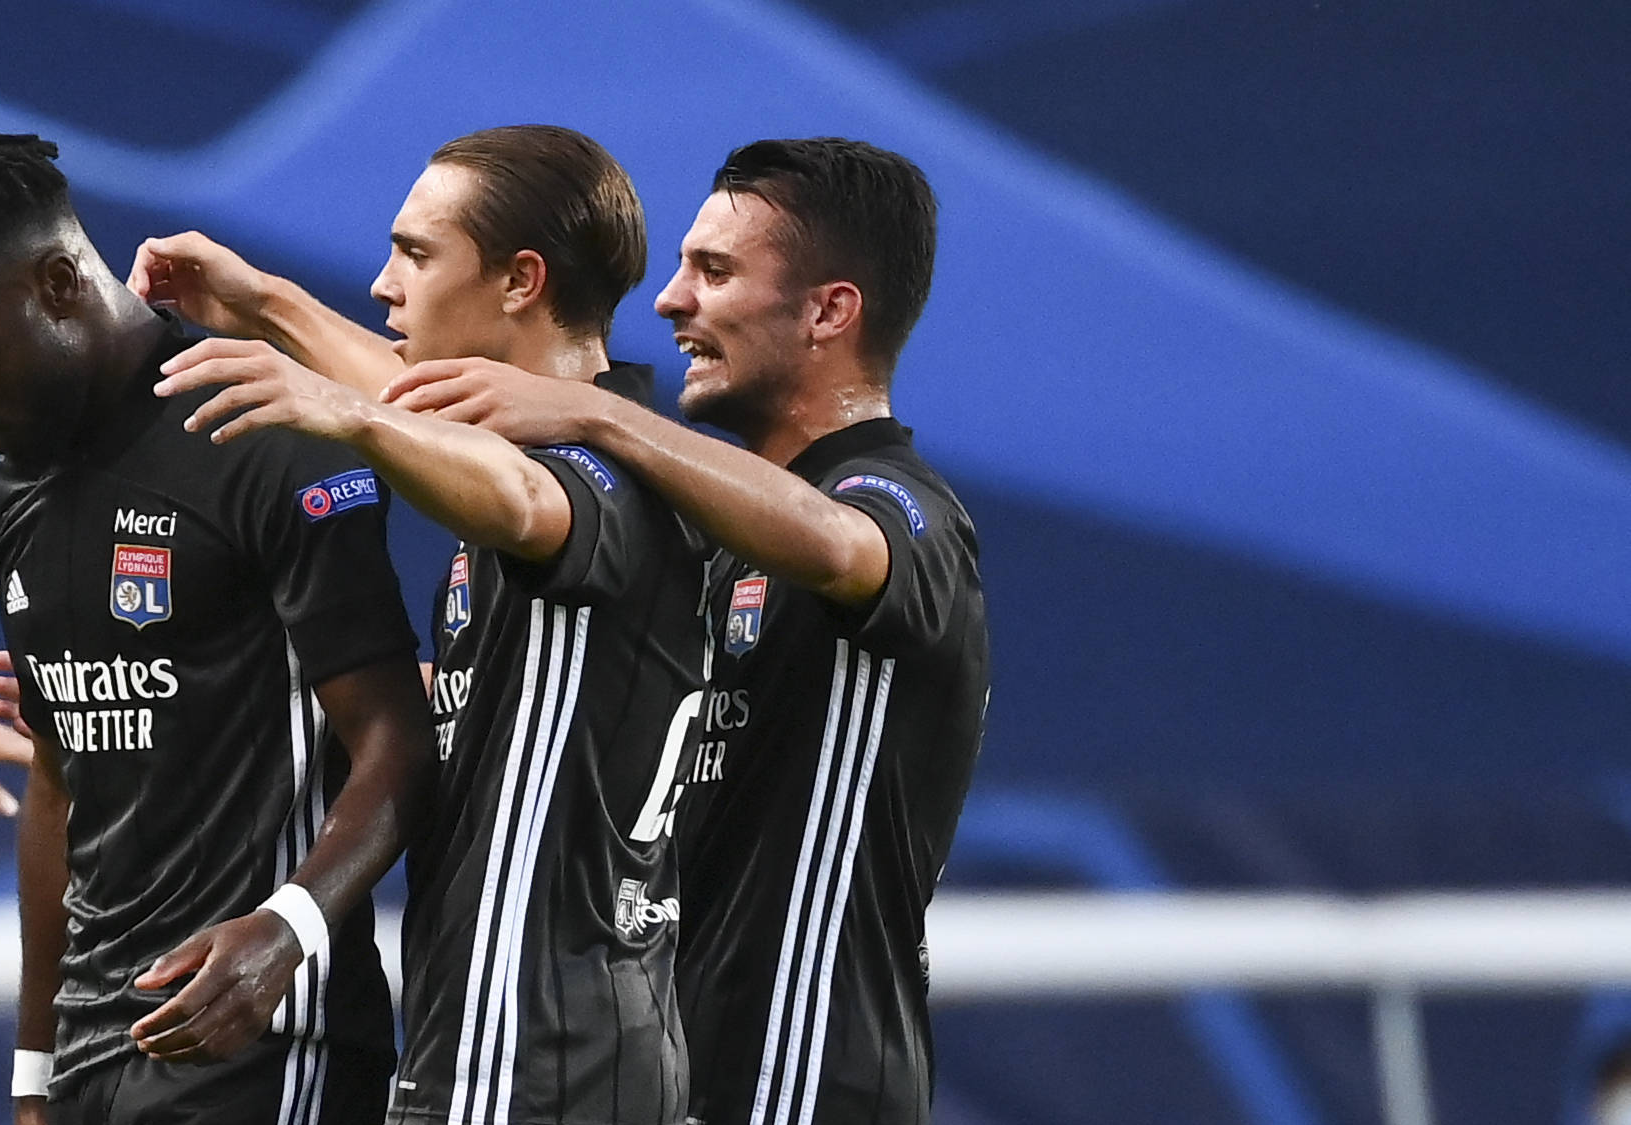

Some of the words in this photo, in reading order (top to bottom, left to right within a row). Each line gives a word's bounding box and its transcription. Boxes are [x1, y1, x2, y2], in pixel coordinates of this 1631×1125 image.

[330, 478, 377, 503] RESPECT
[114, 508, 178, 537] Merci
[118, 550, 165, 565] OLYMPIQUE
[72, 708, 153, 753] BETTER
